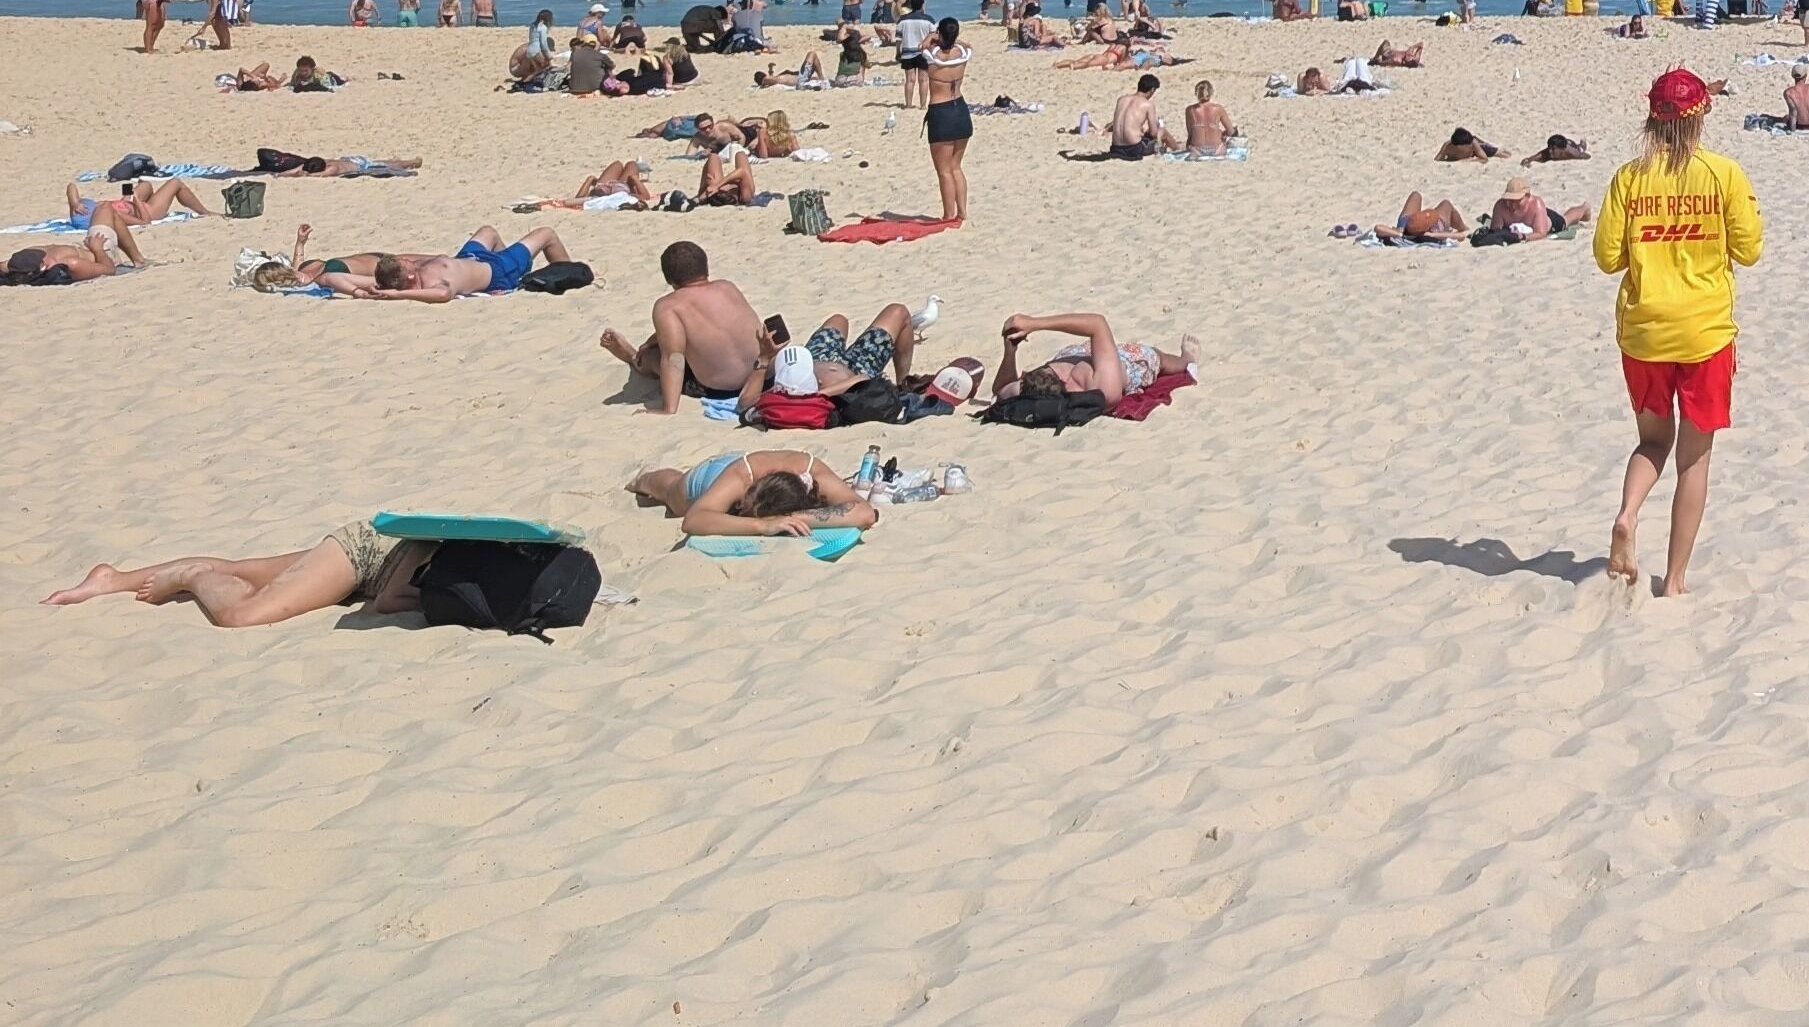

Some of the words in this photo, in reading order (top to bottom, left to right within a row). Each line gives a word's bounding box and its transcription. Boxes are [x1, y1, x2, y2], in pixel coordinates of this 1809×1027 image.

[1629, 196, 1662, 218] SURF
[1667, 194, 1720, 216] RESCUE
[1640, 224, 1706, 243] DHL
